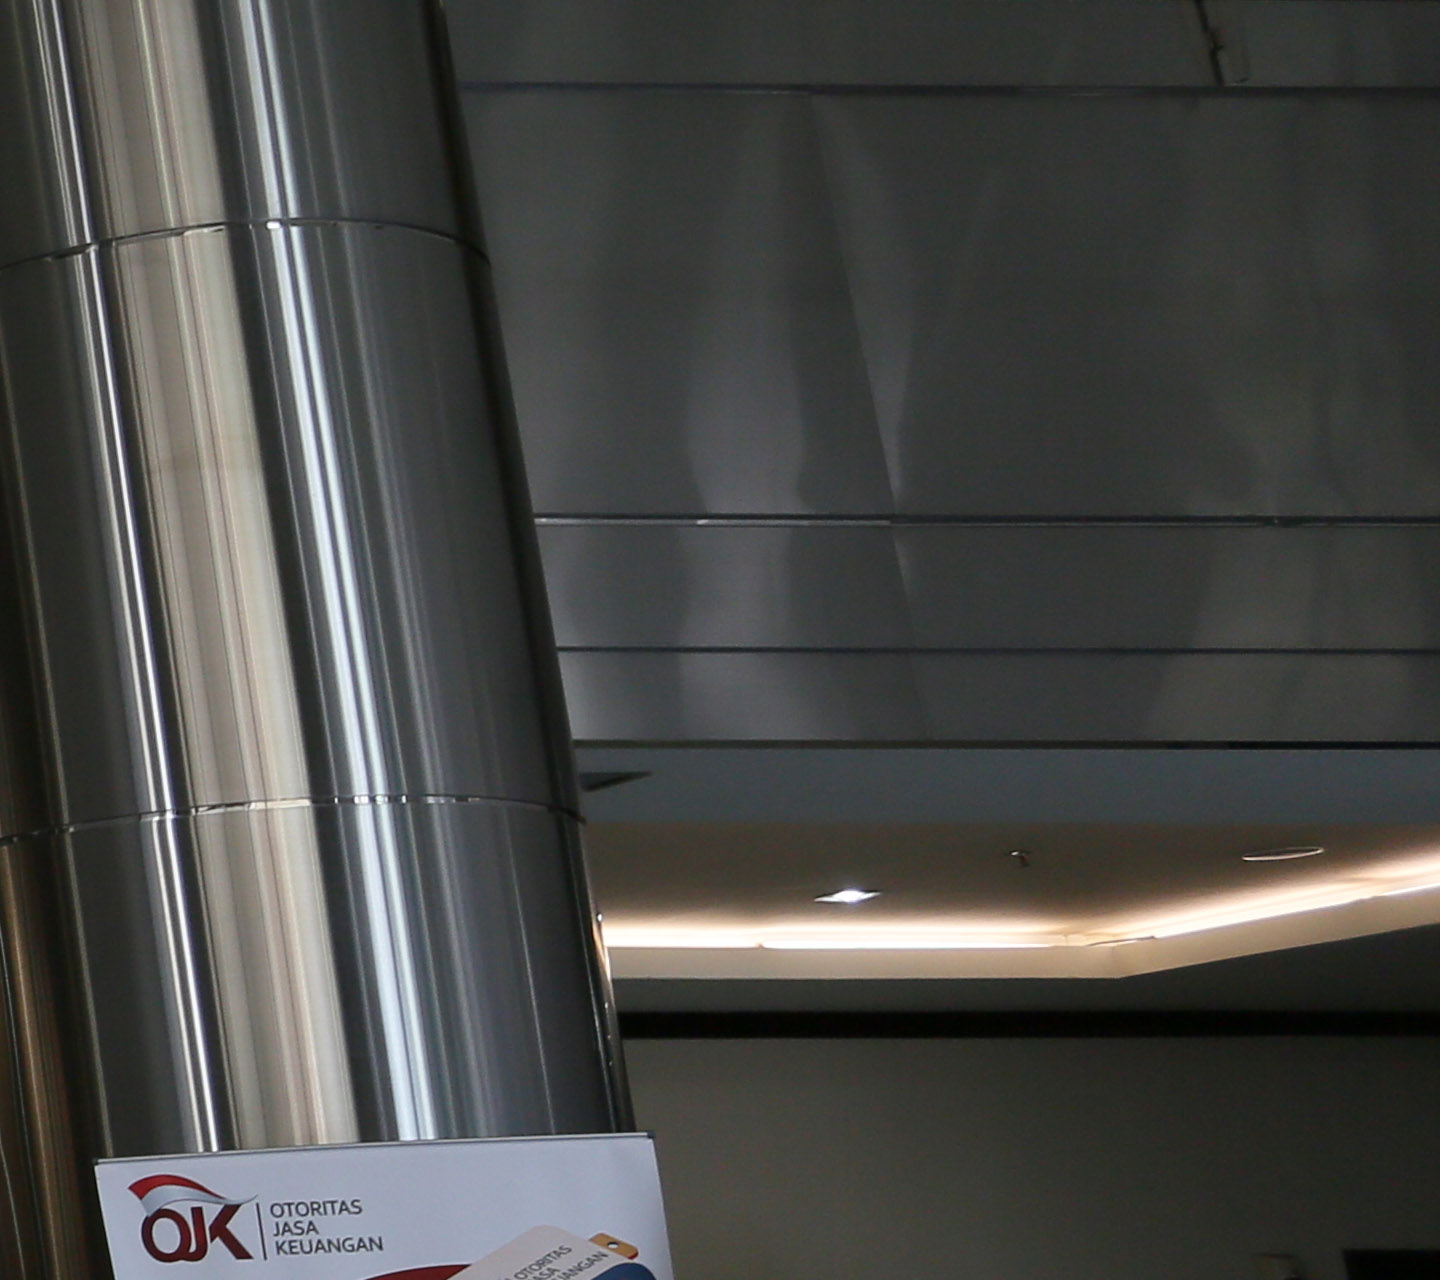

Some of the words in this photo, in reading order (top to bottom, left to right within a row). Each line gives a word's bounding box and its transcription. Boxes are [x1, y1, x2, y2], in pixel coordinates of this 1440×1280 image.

[270, 1199, 363, 1218] OTORITAS
[141, 1203, 254, 1263] OJK
[273, 1220, 319, 1237] JASA
[275, 1236, 384, 1256] KEUANGAN
[514, 1244, 572, 1280] OTORITAS
